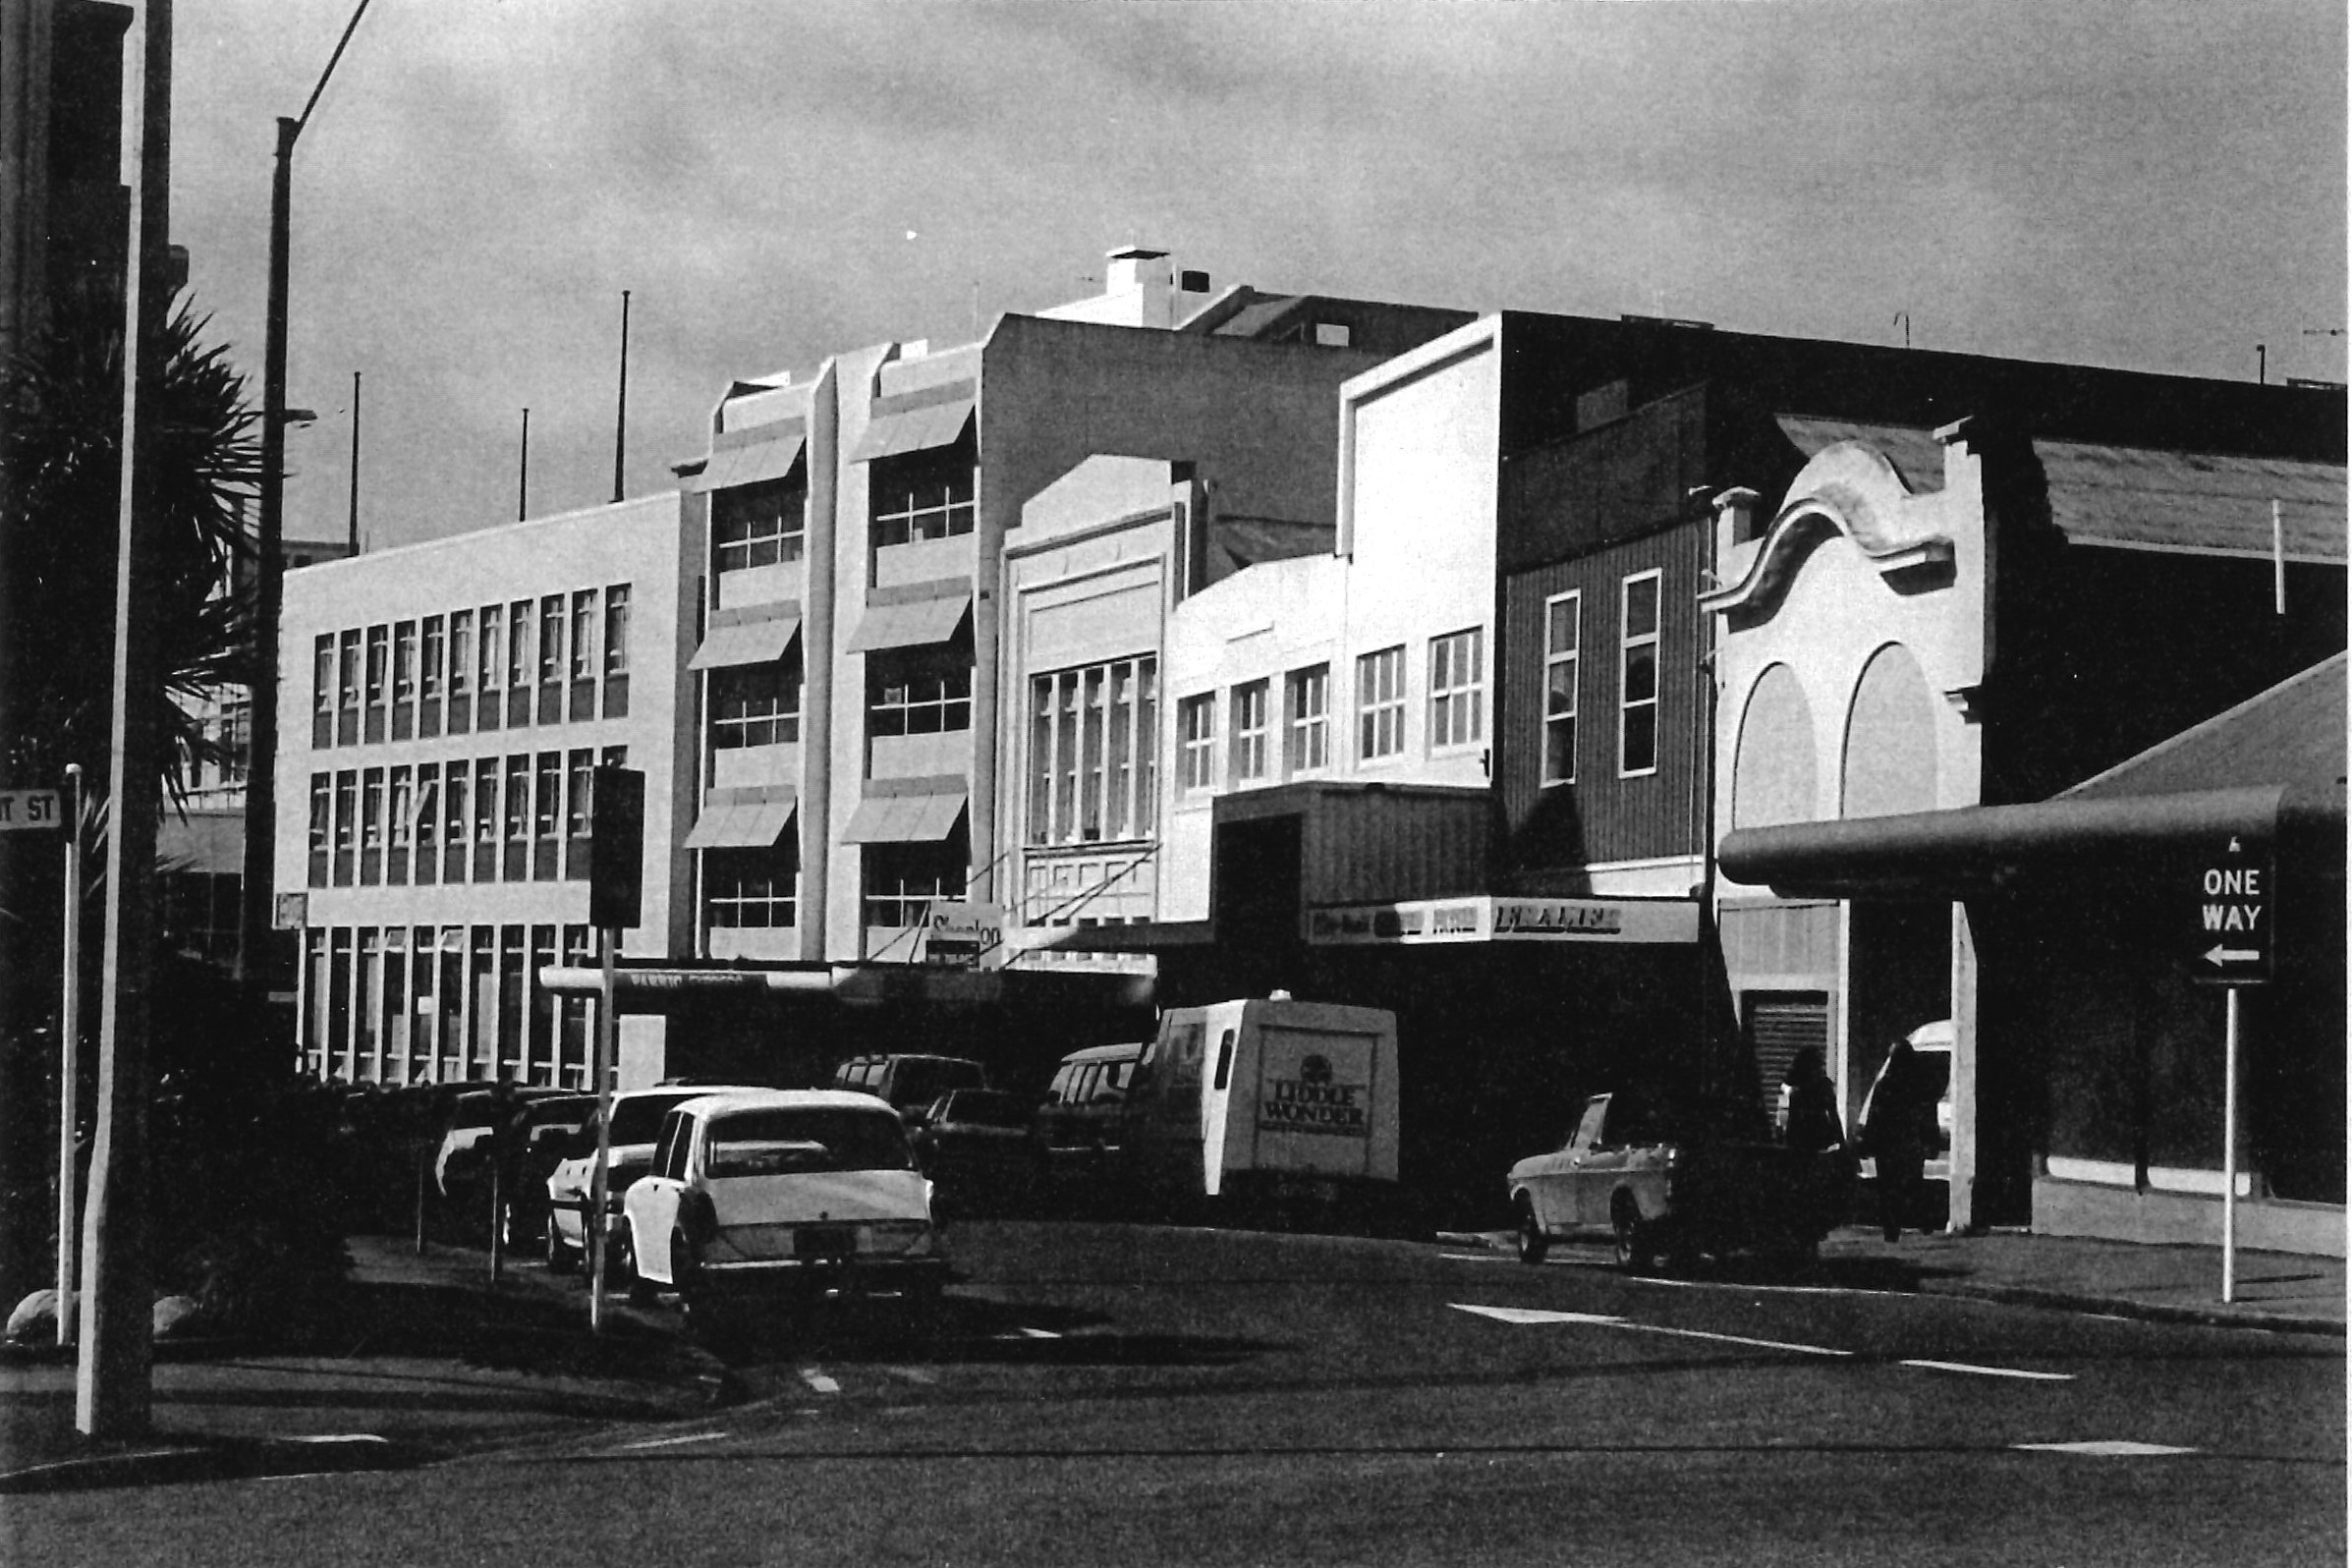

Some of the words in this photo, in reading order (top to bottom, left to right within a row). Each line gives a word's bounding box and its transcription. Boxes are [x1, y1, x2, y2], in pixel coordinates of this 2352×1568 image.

[28, 795, 54, 821] ST
[2204, 868, 2260, 896] ONE
[2202, 903, 2262, 931] WAY
[1264, 1100, 1364, 1126] WONDER
